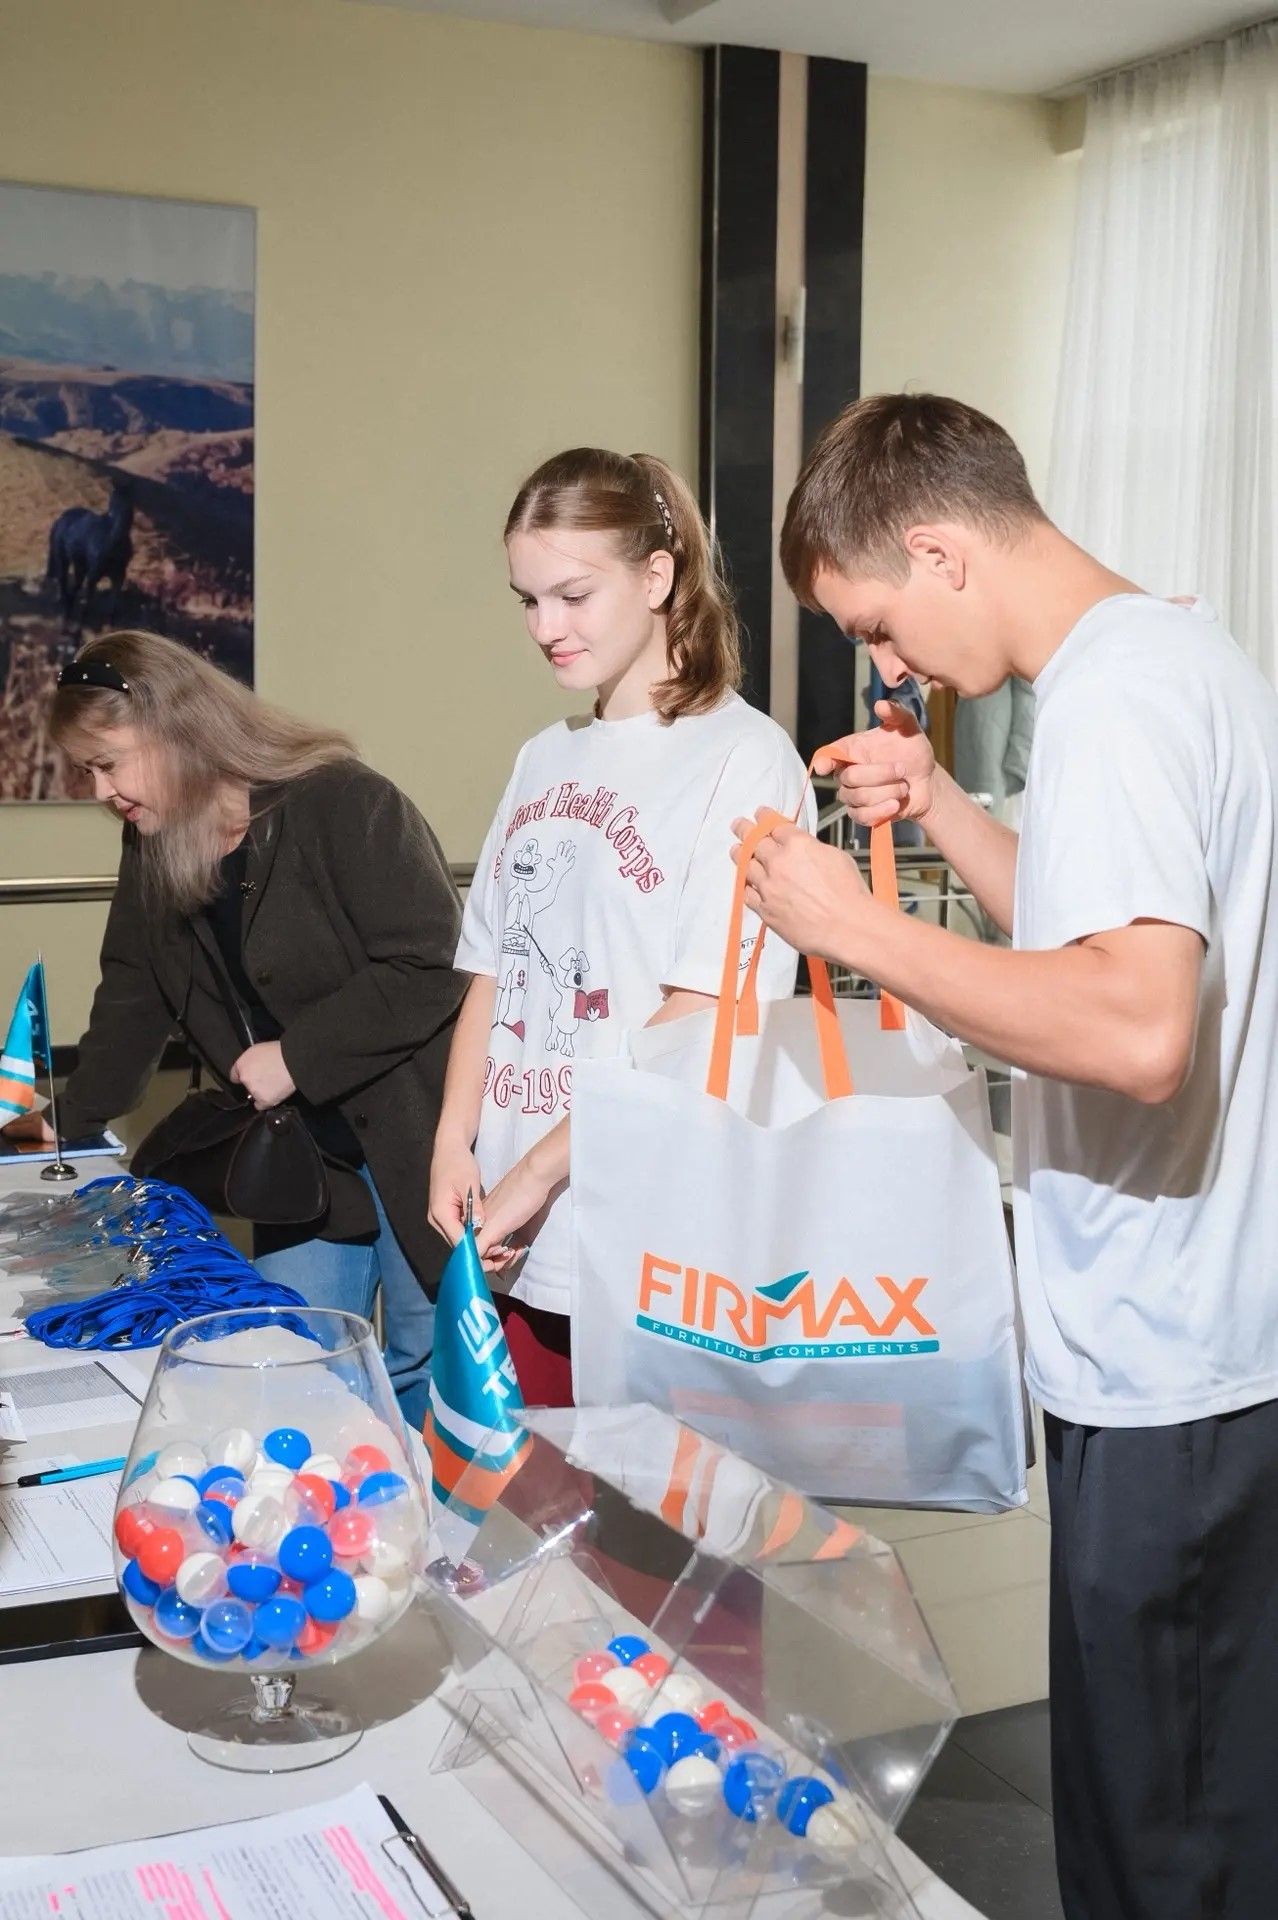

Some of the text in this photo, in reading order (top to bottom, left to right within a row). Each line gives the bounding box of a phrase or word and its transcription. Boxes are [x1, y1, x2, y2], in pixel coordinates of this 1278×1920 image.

[550, 782, 618, 828] Health
[606, 806, 665, 893] Corps
[639, 1252, 937, 1347] FIRMAX
[652, 1322, 920, 1362] FURNITURE COMPONENTS
